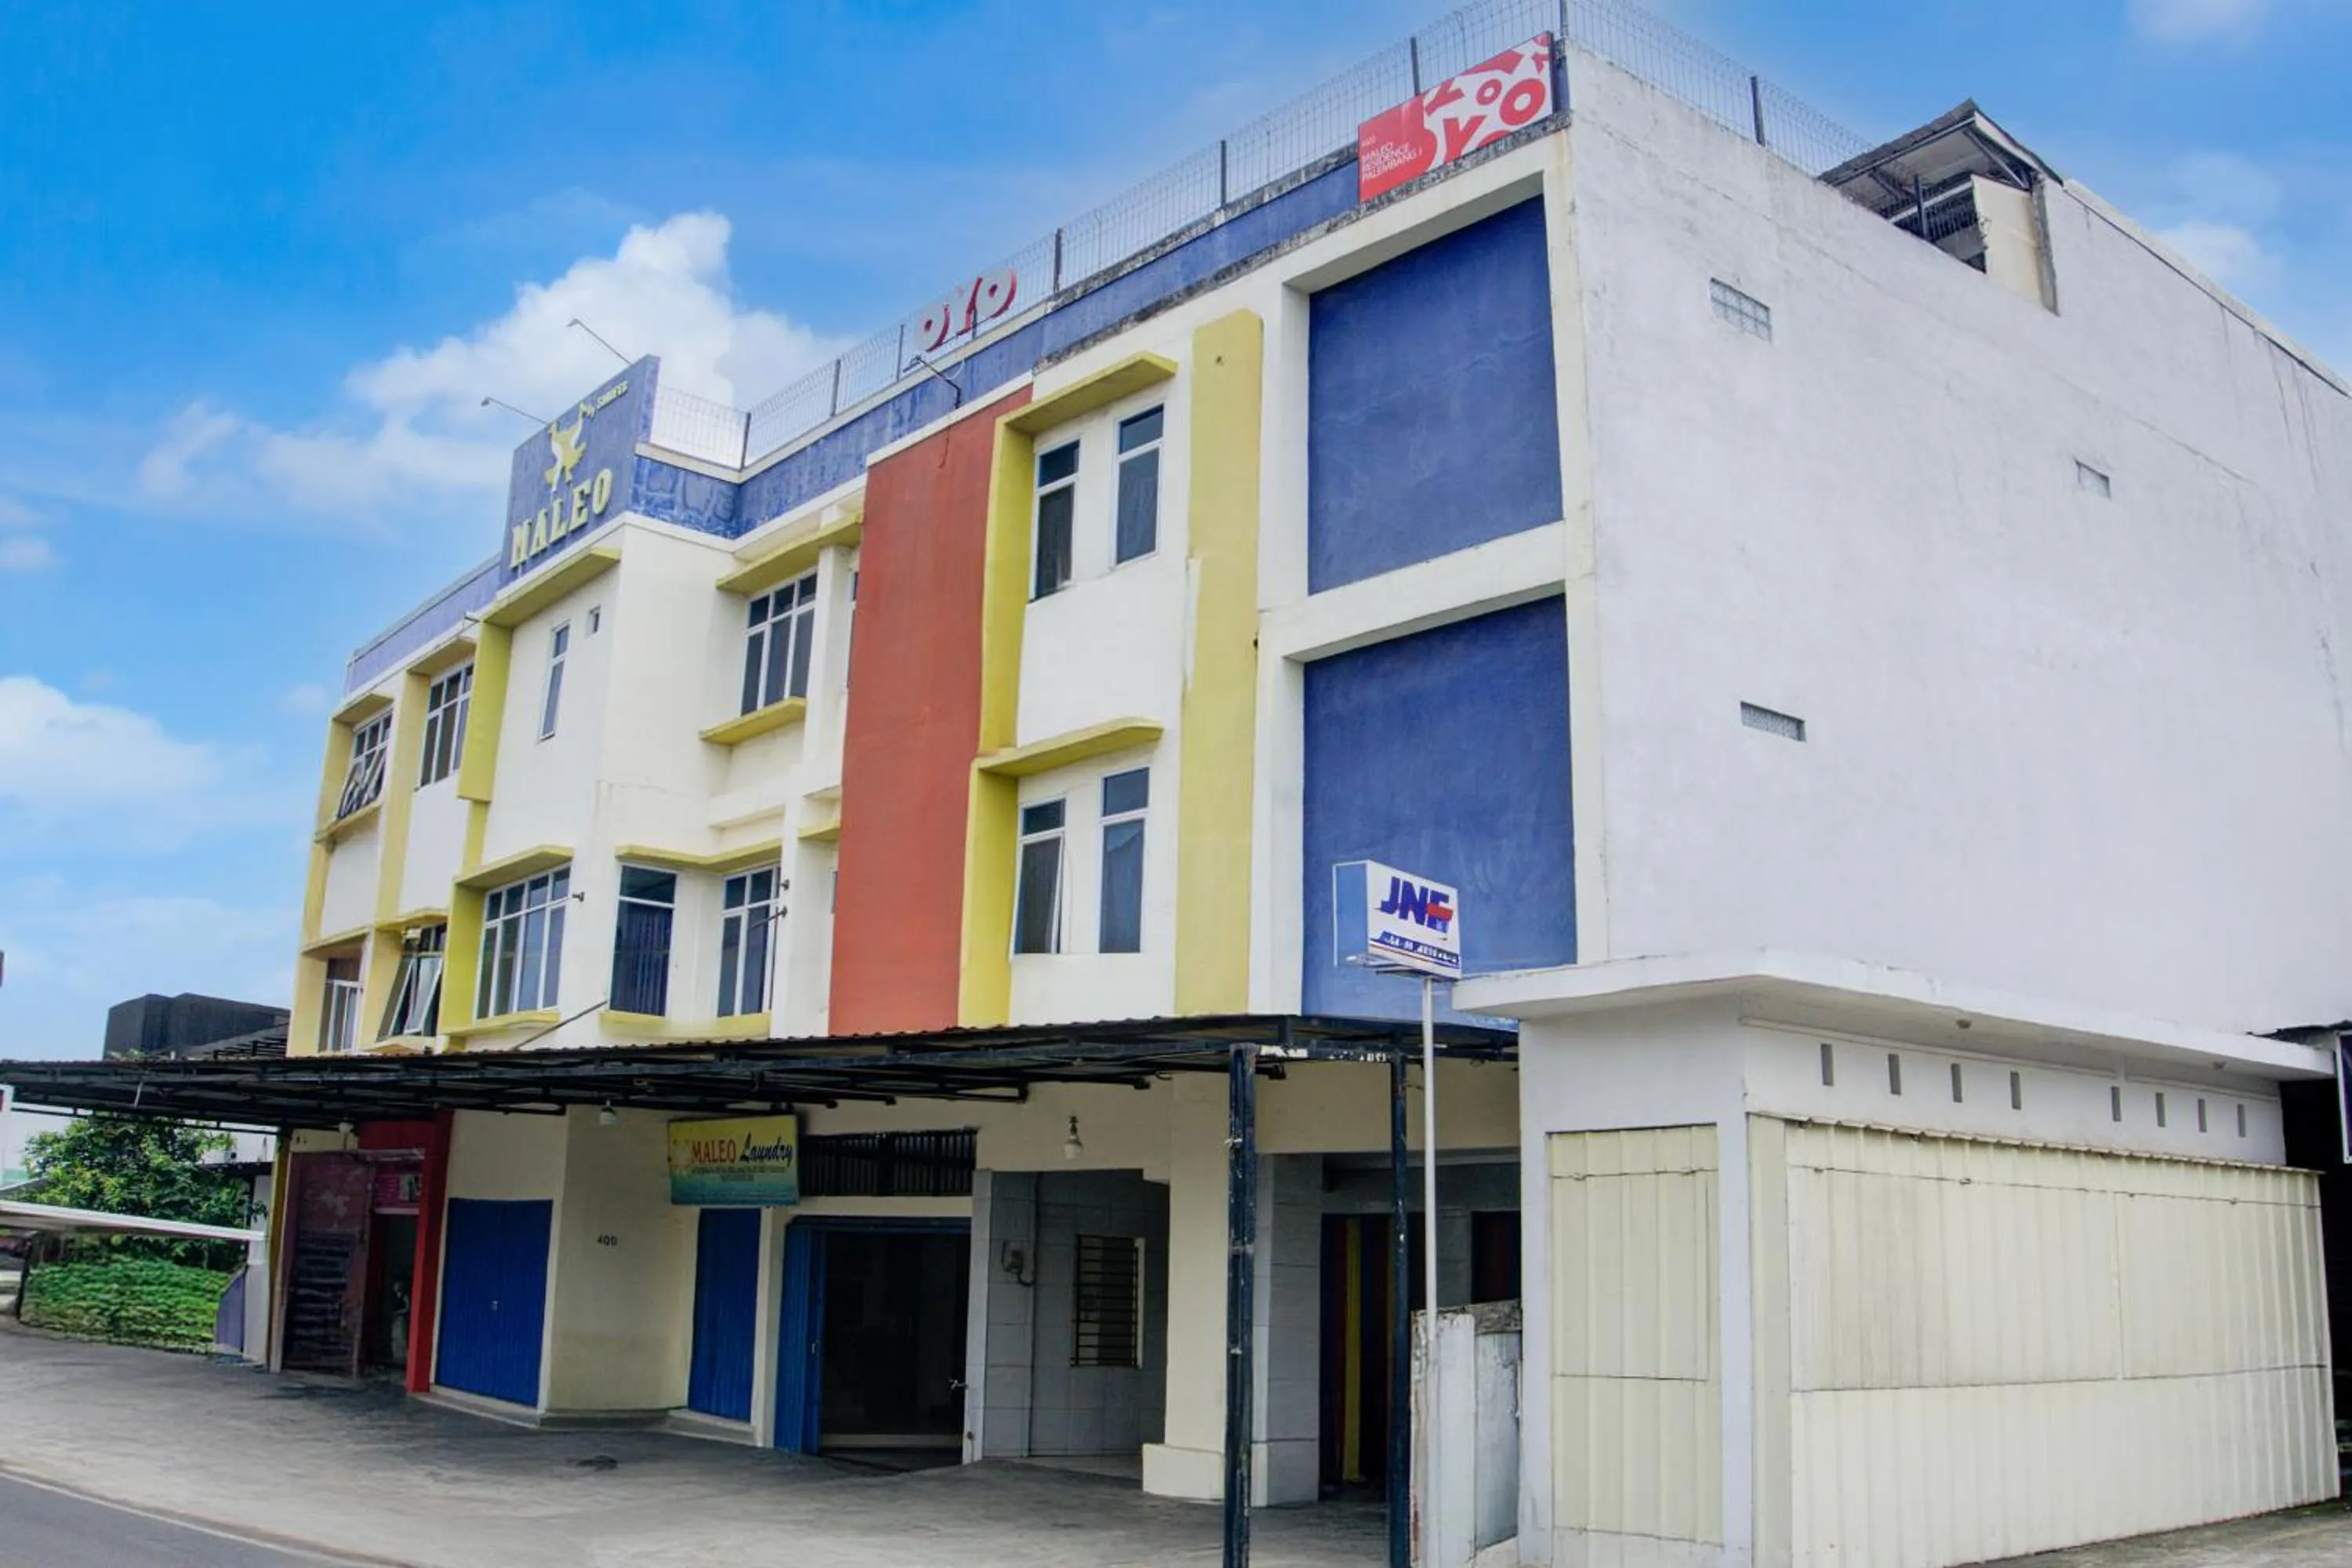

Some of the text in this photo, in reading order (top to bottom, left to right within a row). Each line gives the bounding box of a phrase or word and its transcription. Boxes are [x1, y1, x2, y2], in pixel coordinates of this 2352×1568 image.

[915, 267, 1018, 352] OYO
[510, 468, 612, 568] MALEO
[1380, 876, 1454, 935] JNE
[691, 1132, 793, 1167] MALEO Laundry
